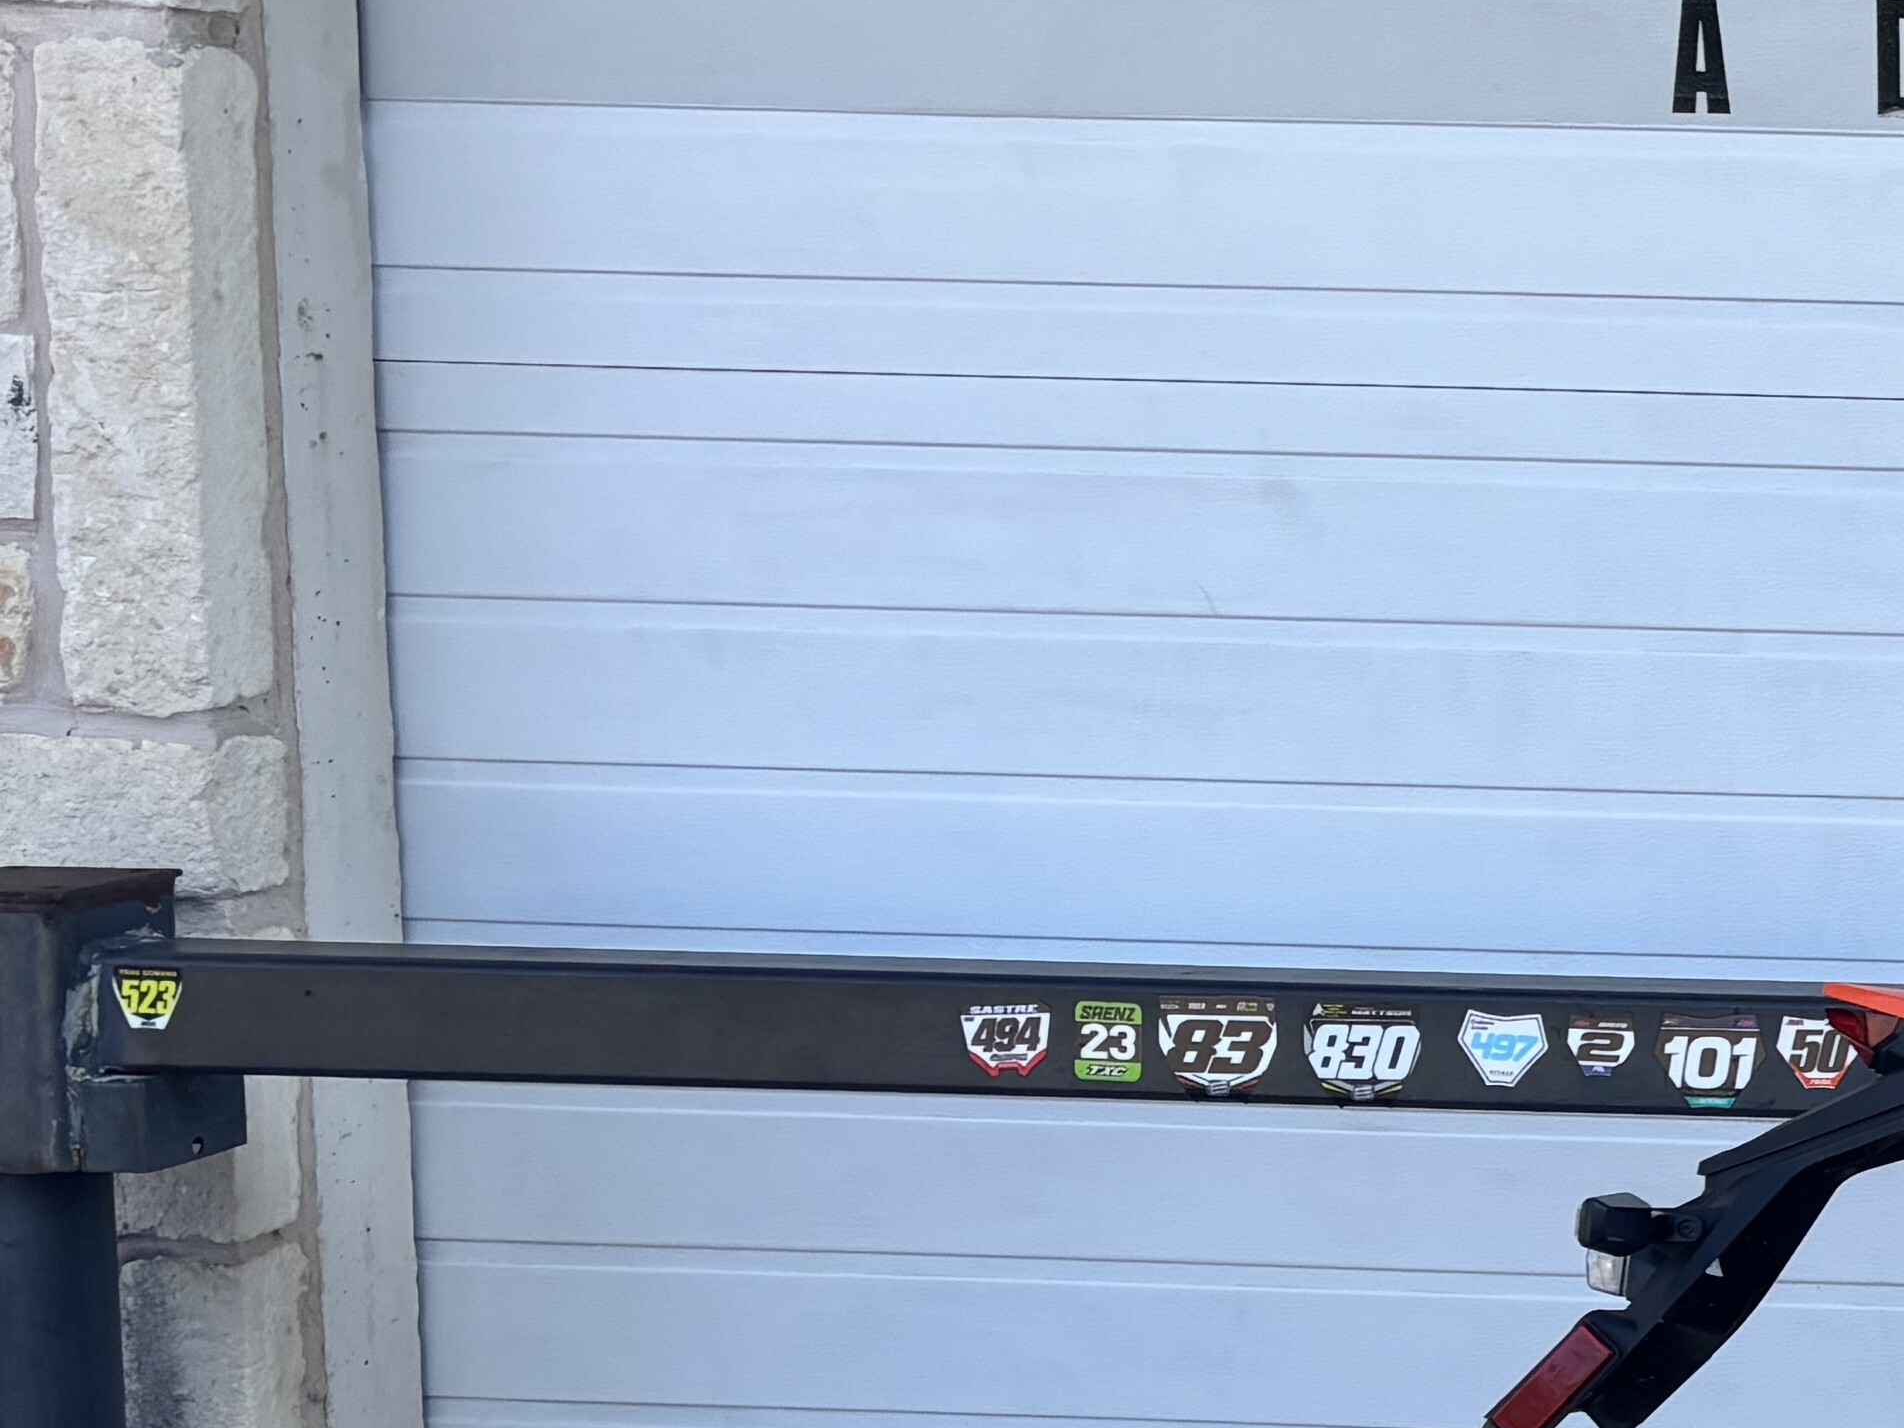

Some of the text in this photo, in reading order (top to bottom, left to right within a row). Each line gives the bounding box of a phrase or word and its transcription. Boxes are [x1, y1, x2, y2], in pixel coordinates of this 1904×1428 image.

[121, 979, 176, 1014] 523
[971, 1017, 1041, 1052] 494
[1080, 1023, 1136, 1061] 23
[1166, 1019, 1273, 1074] 83
[1308, 1024, 1421, 1080] 830
[1471, 1032, 1540, 1062] 497
[1576, 1032, 1625, 1063] 2
[1788, 1029, 1851, 1073] 50
[1664, 1036, 1758, 1090] 101
